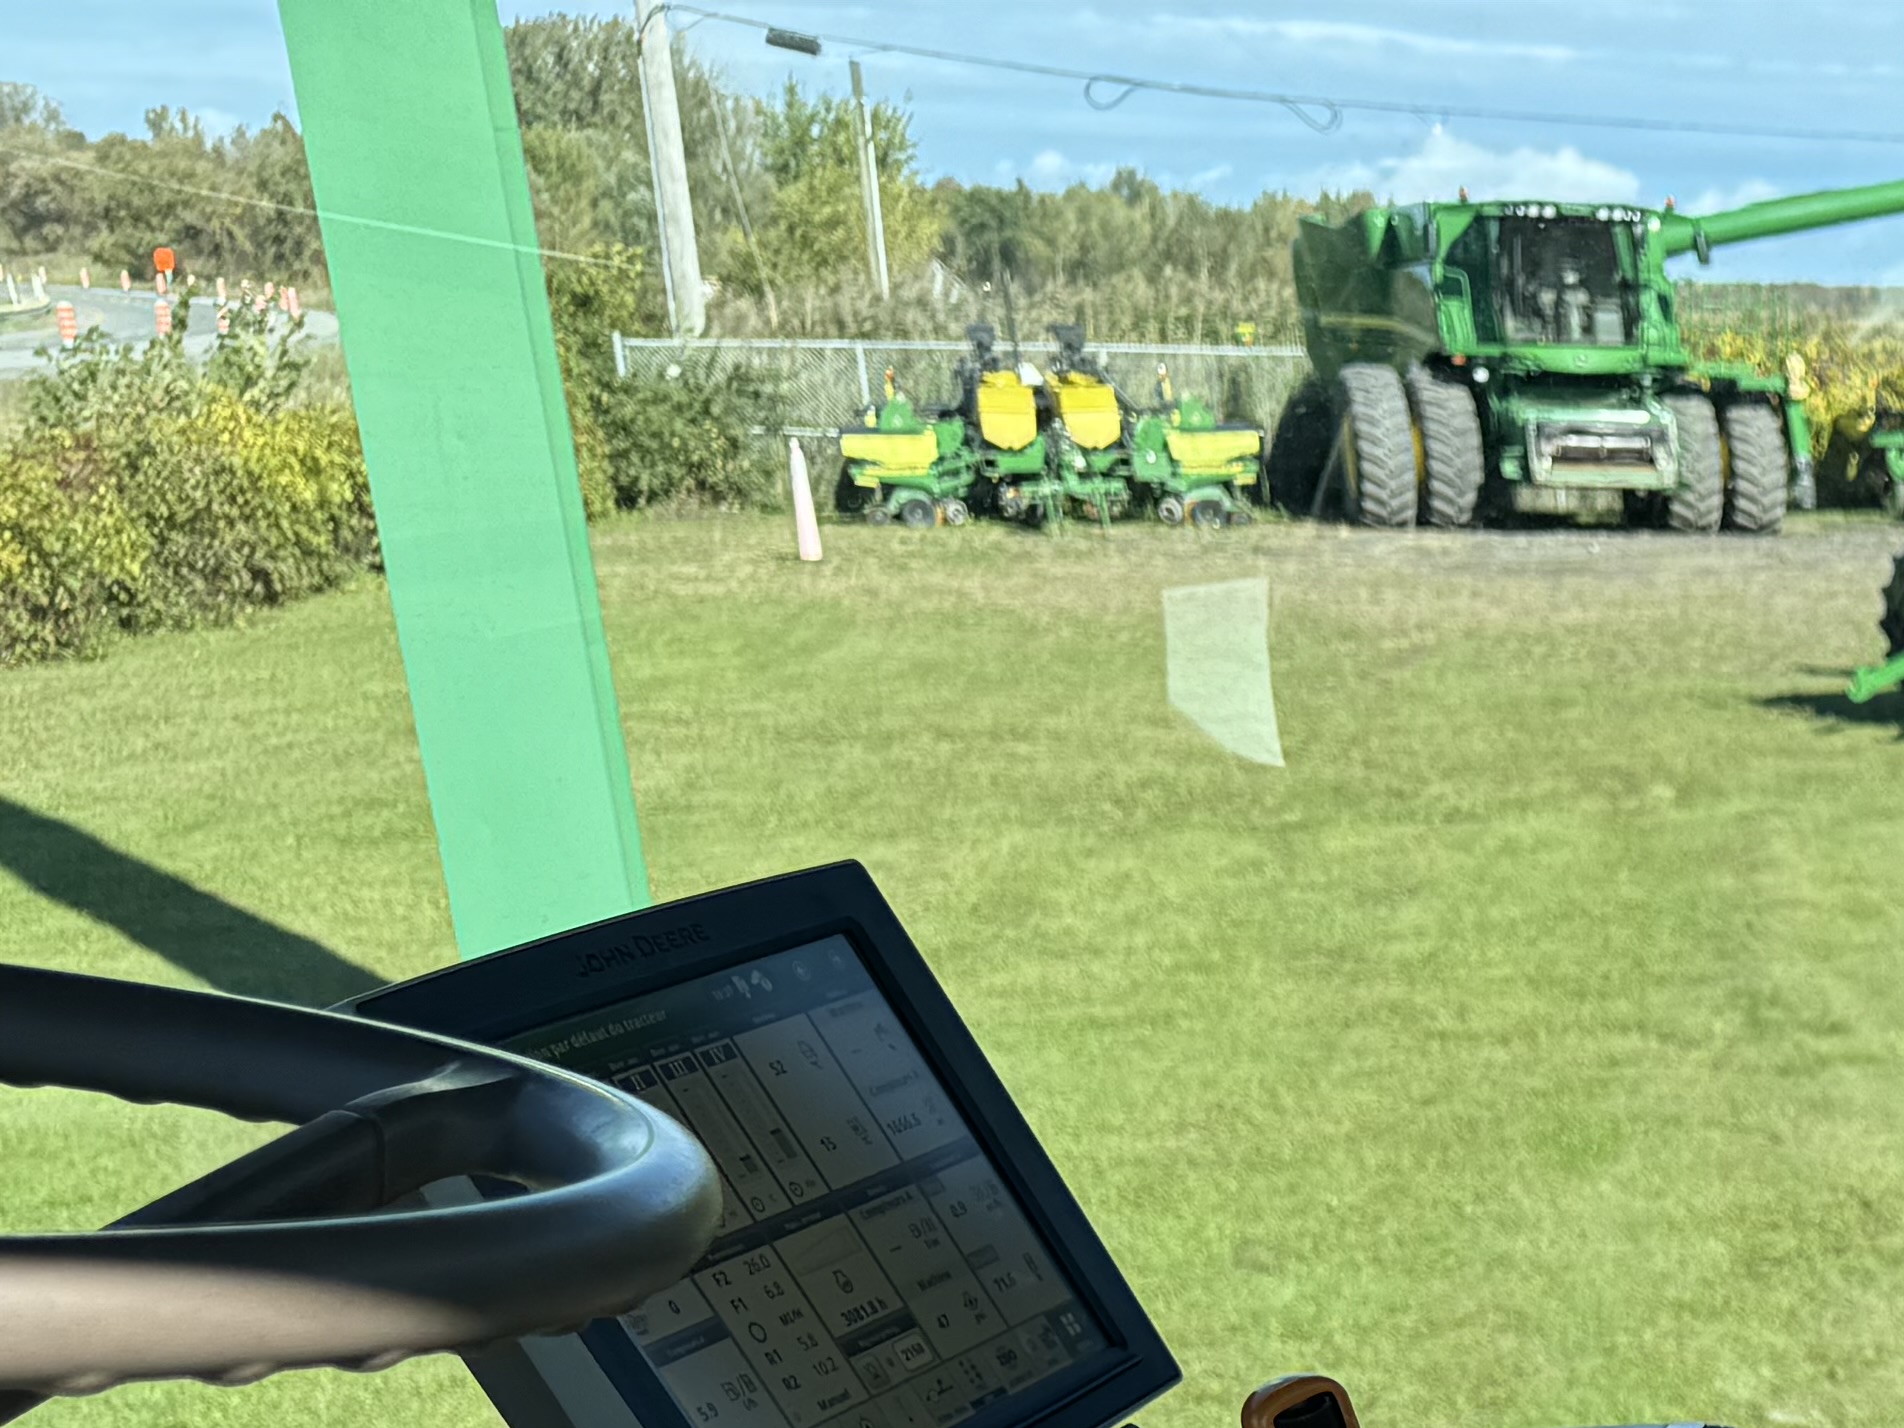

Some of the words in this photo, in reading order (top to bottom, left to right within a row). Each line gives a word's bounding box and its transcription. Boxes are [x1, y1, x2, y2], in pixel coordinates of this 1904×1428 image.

[576, 944, 637, 978] JOHN
[631, 922, 711, 959] DEERE
[711, 1269, 733, 1288] F2
[729, 1296, 750, 1315] F1
[763, 1348, 785, 1367] R1
[781, 1373, 803, 1392] R2
